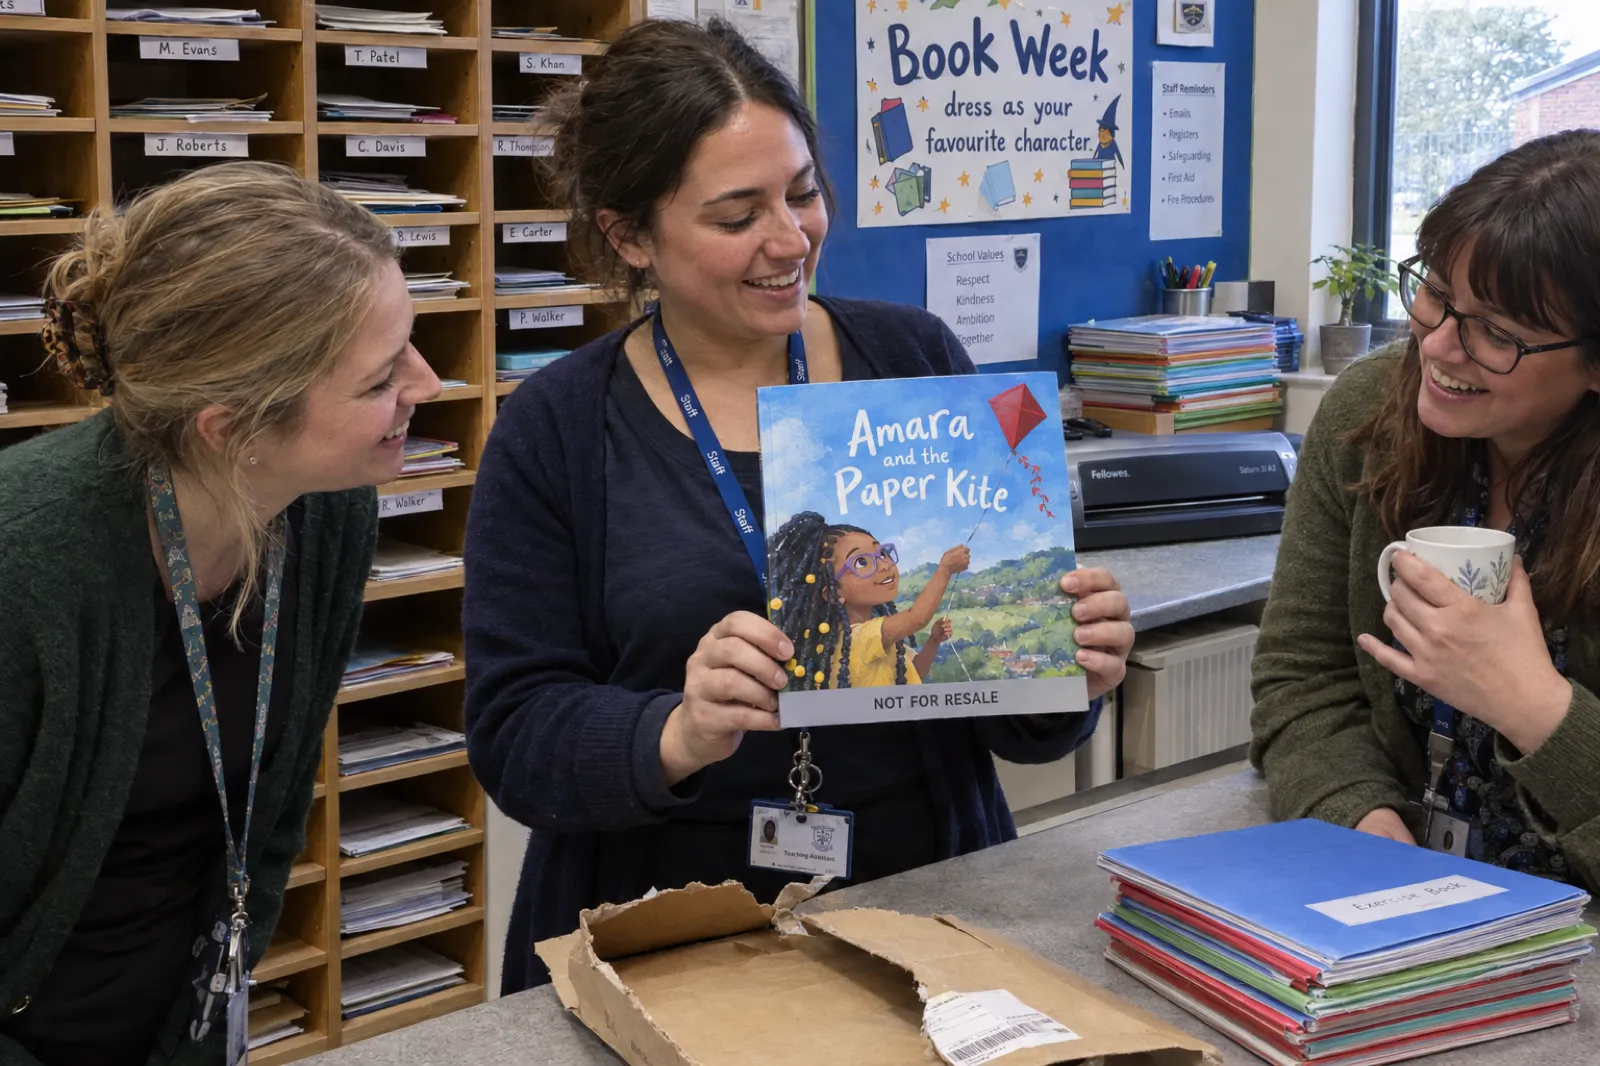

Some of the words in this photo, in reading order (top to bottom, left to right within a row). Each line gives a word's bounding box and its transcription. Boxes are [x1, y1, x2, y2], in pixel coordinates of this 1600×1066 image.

[159, 42, 175, 55] M.
[183, 42, 217, 56] Evans
[888, 16, 999, 86] Book
[1009, 19, 1109, 84] Week
[354, 50, 365, 62] T.
[370, 50, 400, 63] Patel
[526, 58, 536, 69] S.
[541, 58, 565, 69] Khan
[1162, 83, 1178, 94] Staff
[1179, 84, 1216, 95] Reminders
[944, 90, 992, 117] dress
[1002, 99, 1025, 116] as
[1034, 100, 1073, 125] your
[1169, 108, 1191, 119] Emails
[925, 127, 1006, 154] favourite
[1014, 127, 1093, 153] character.
[1169, 129, 1199, 142] Registers
[156, 138, 169, 152] J.
[176, 138, 227, 153] Roberts
[358, 140, 370, 152] C.
[375, 140, 405, 153] Davis
[498, 139, 507, 151] R.
[1168, 150, 1211, 164] Safeguarding
[1168, 173, 1182, 183] First
[1183, 172, 1195, 183] Aid
[1167, 194, 1180, 204] Fire
[1181, 193, 1215, 204] Procedures
[411, 230, 436, 242] Lewis
[509, 227, 519, 238] E.
[523, 227, 553, 238] Carter
[947, 250, 975, 263] School
[977, 249, 1004, 261] Values
[956, 274, 990, 287] Respect
[956, 293, 995, 306] Kindness
[520, 312, 528, 324] P.
[532, 311, 565, 323] Walker
[956, 312, 995, 325] Ambition
[680, 394, 699, 419] Staff
[847, 409, 974, 458] Amara
[707, 450, 726, 476] Staff
[883, 447, 917, 467] and
[921, 446, 949, 465] the
[834, 466, 936, 516] Paper
[945, 467, 1009, 513] Kite
[382, 499, 391, 511] R.
[734, 508, 755, 535] Staff
[874, 696, 904, 710] NOT
[910, 694, 939, 708] FOR
[945, 691, 999, 706] RESALE
[784, 850, 809, 860] Teaching
[1352, 892, 1421, 911] Exercise
[1424, 882, 1467, 896] Book
